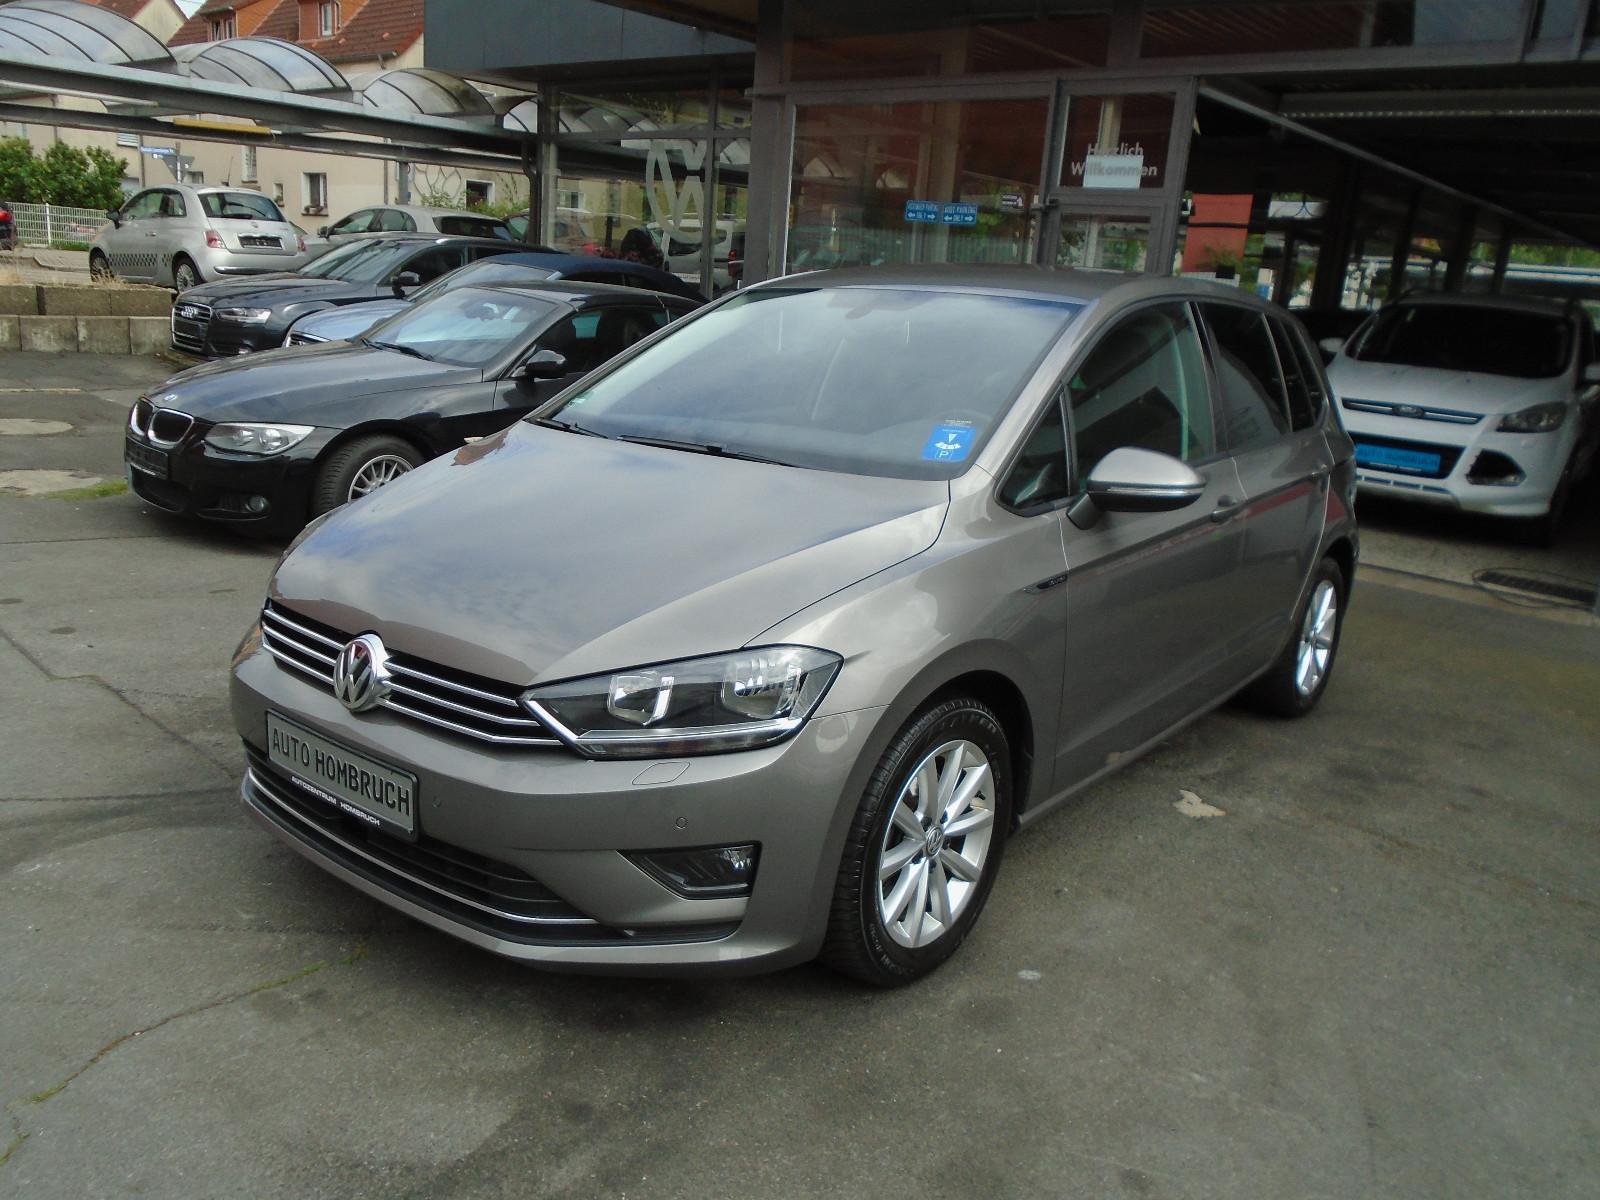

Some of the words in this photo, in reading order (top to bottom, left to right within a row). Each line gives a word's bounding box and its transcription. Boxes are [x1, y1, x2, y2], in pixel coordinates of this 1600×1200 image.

[272, 727, 310, 767] AUTO
[315, 747, 410, 816] HOMBRUCH
[291, 775, 337, 805] AUTOZENTRUM
[340, 801, 380, 826] HOMBRUCH
